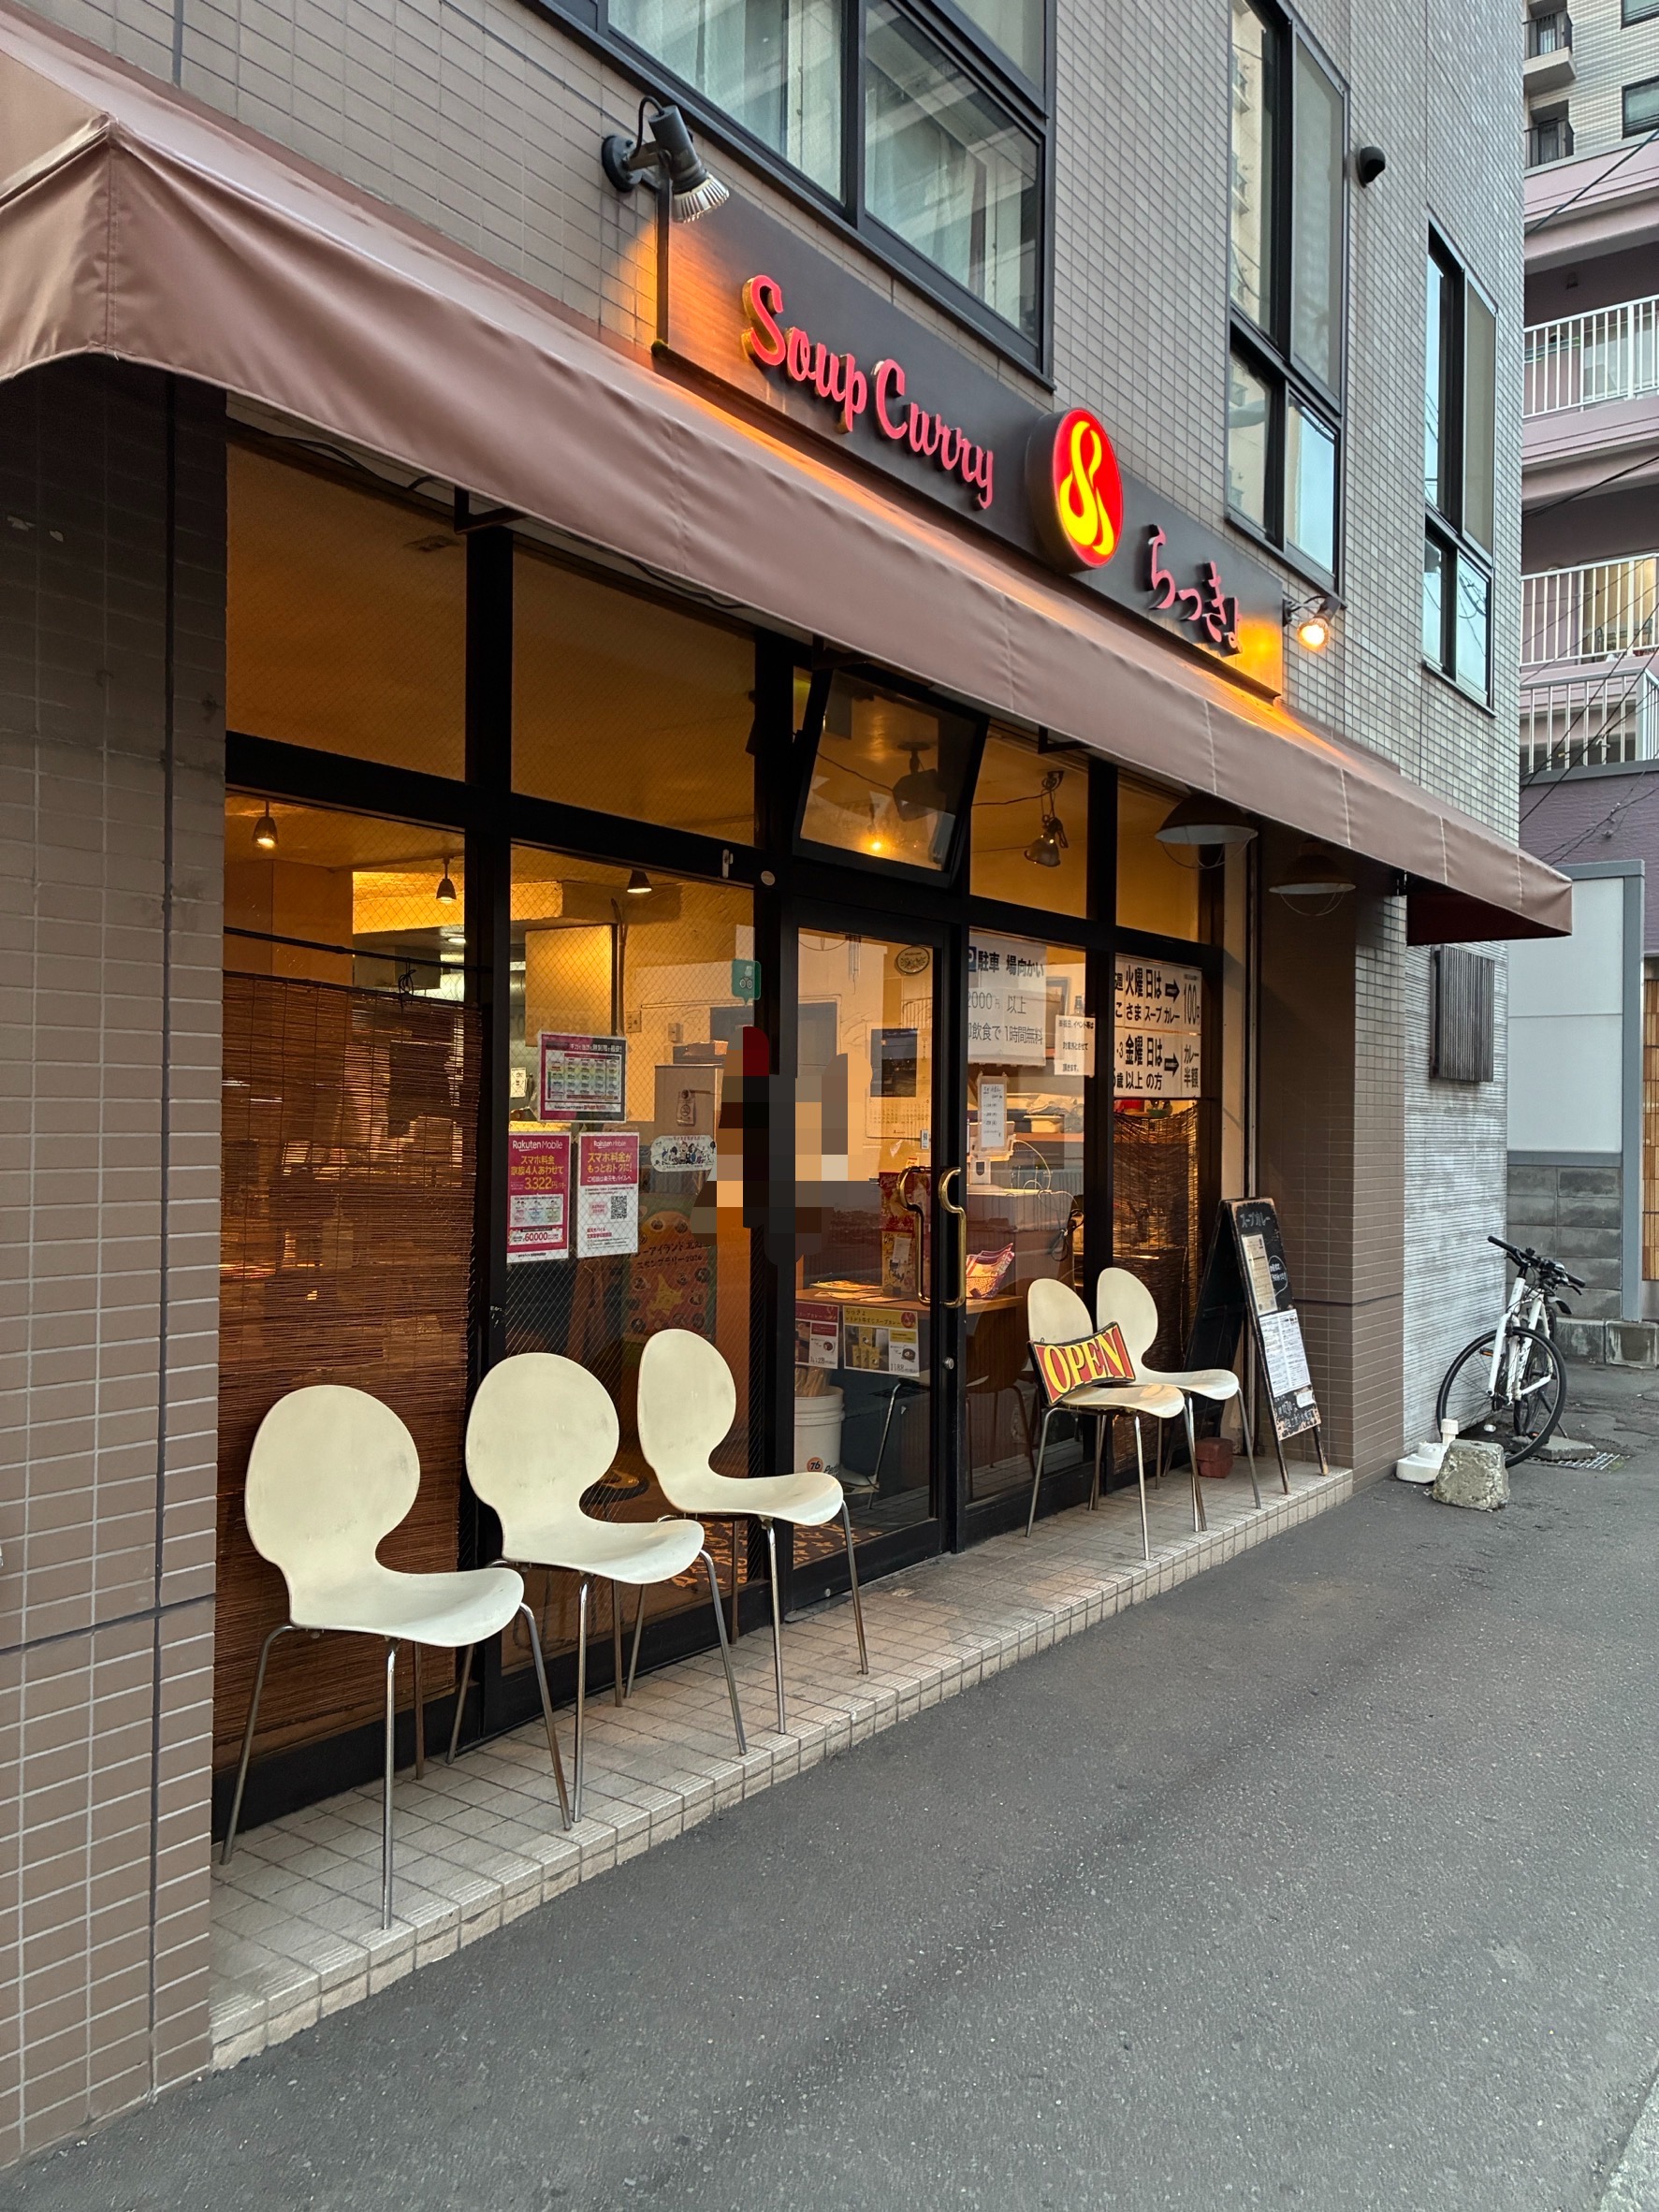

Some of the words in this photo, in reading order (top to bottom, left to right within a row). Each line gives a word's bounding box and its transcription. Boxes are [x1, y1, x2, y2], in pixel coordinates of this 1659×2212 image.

[741, 274, 868, 433] Soup
[871, 358, 994, 510] Curry
[1148, 524, 1244, 655] らっきょ
[968, 1022, 1044, 1046] 飲食で1時間無料
[1183, 1043, 1201, 1065] カレー
[512, 1139, 542, 1152] Rakuten
[542, 1140, 563, 1150] Mobile
[520, 1155, 555, 1165] スマホ料金
[588, 1152, 633, 1163] スマホ料金が
[1043, 1328, 1127, 1394] OPEN
[809, 1461, 821, 1470] 76
